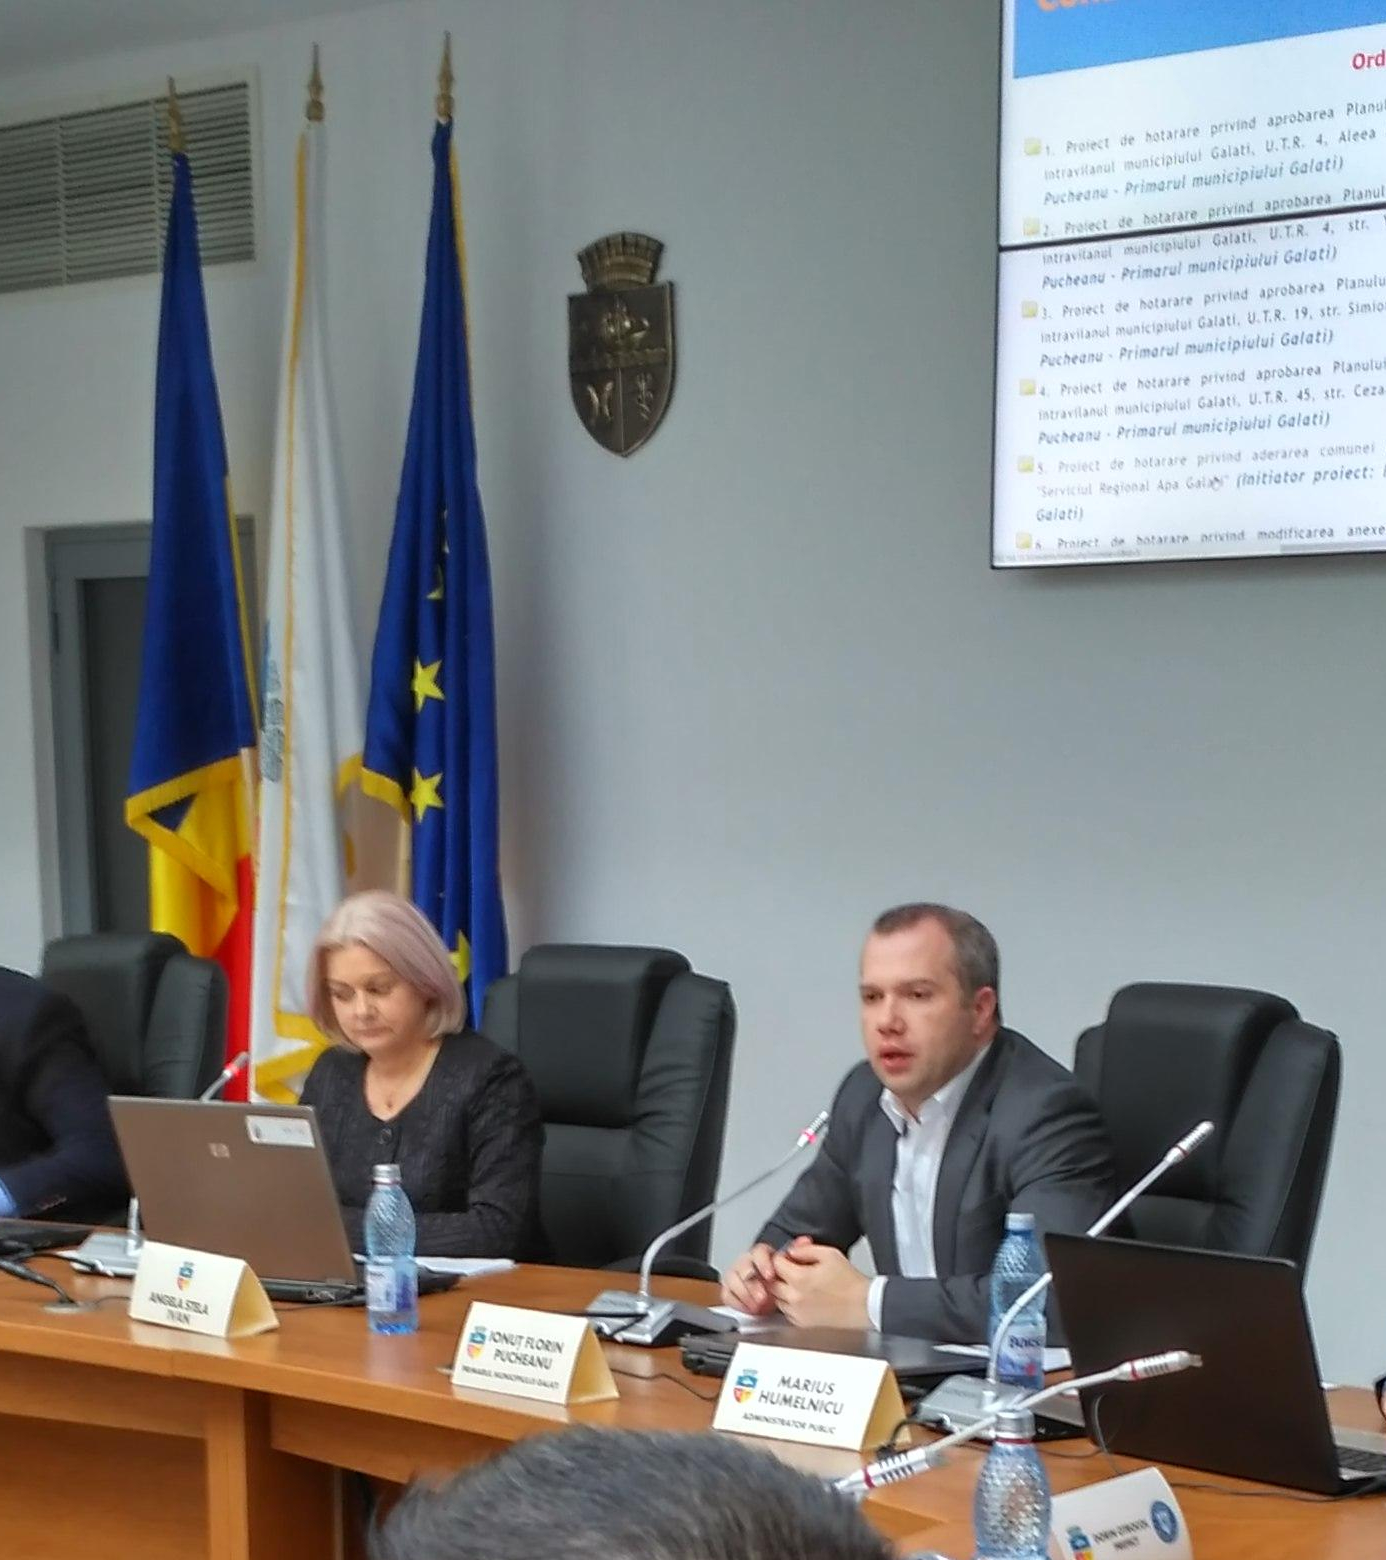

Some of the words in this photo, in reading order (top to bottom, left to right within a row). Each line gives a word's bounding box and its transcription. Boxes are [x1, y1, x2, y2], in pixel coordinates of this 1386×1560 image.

[525, 1335, 565, 1354] FLORIN
[493, 1348, 553, 1370] PUCHEANU
[777, 1375, 836, 1396] MARIUS
[758, 1390, 845, 1416] HUMELNICU
[742, 1412, 807, 1430] ADMINISTRATOR
[807, 1421, 836, 1435] PUBLIC
